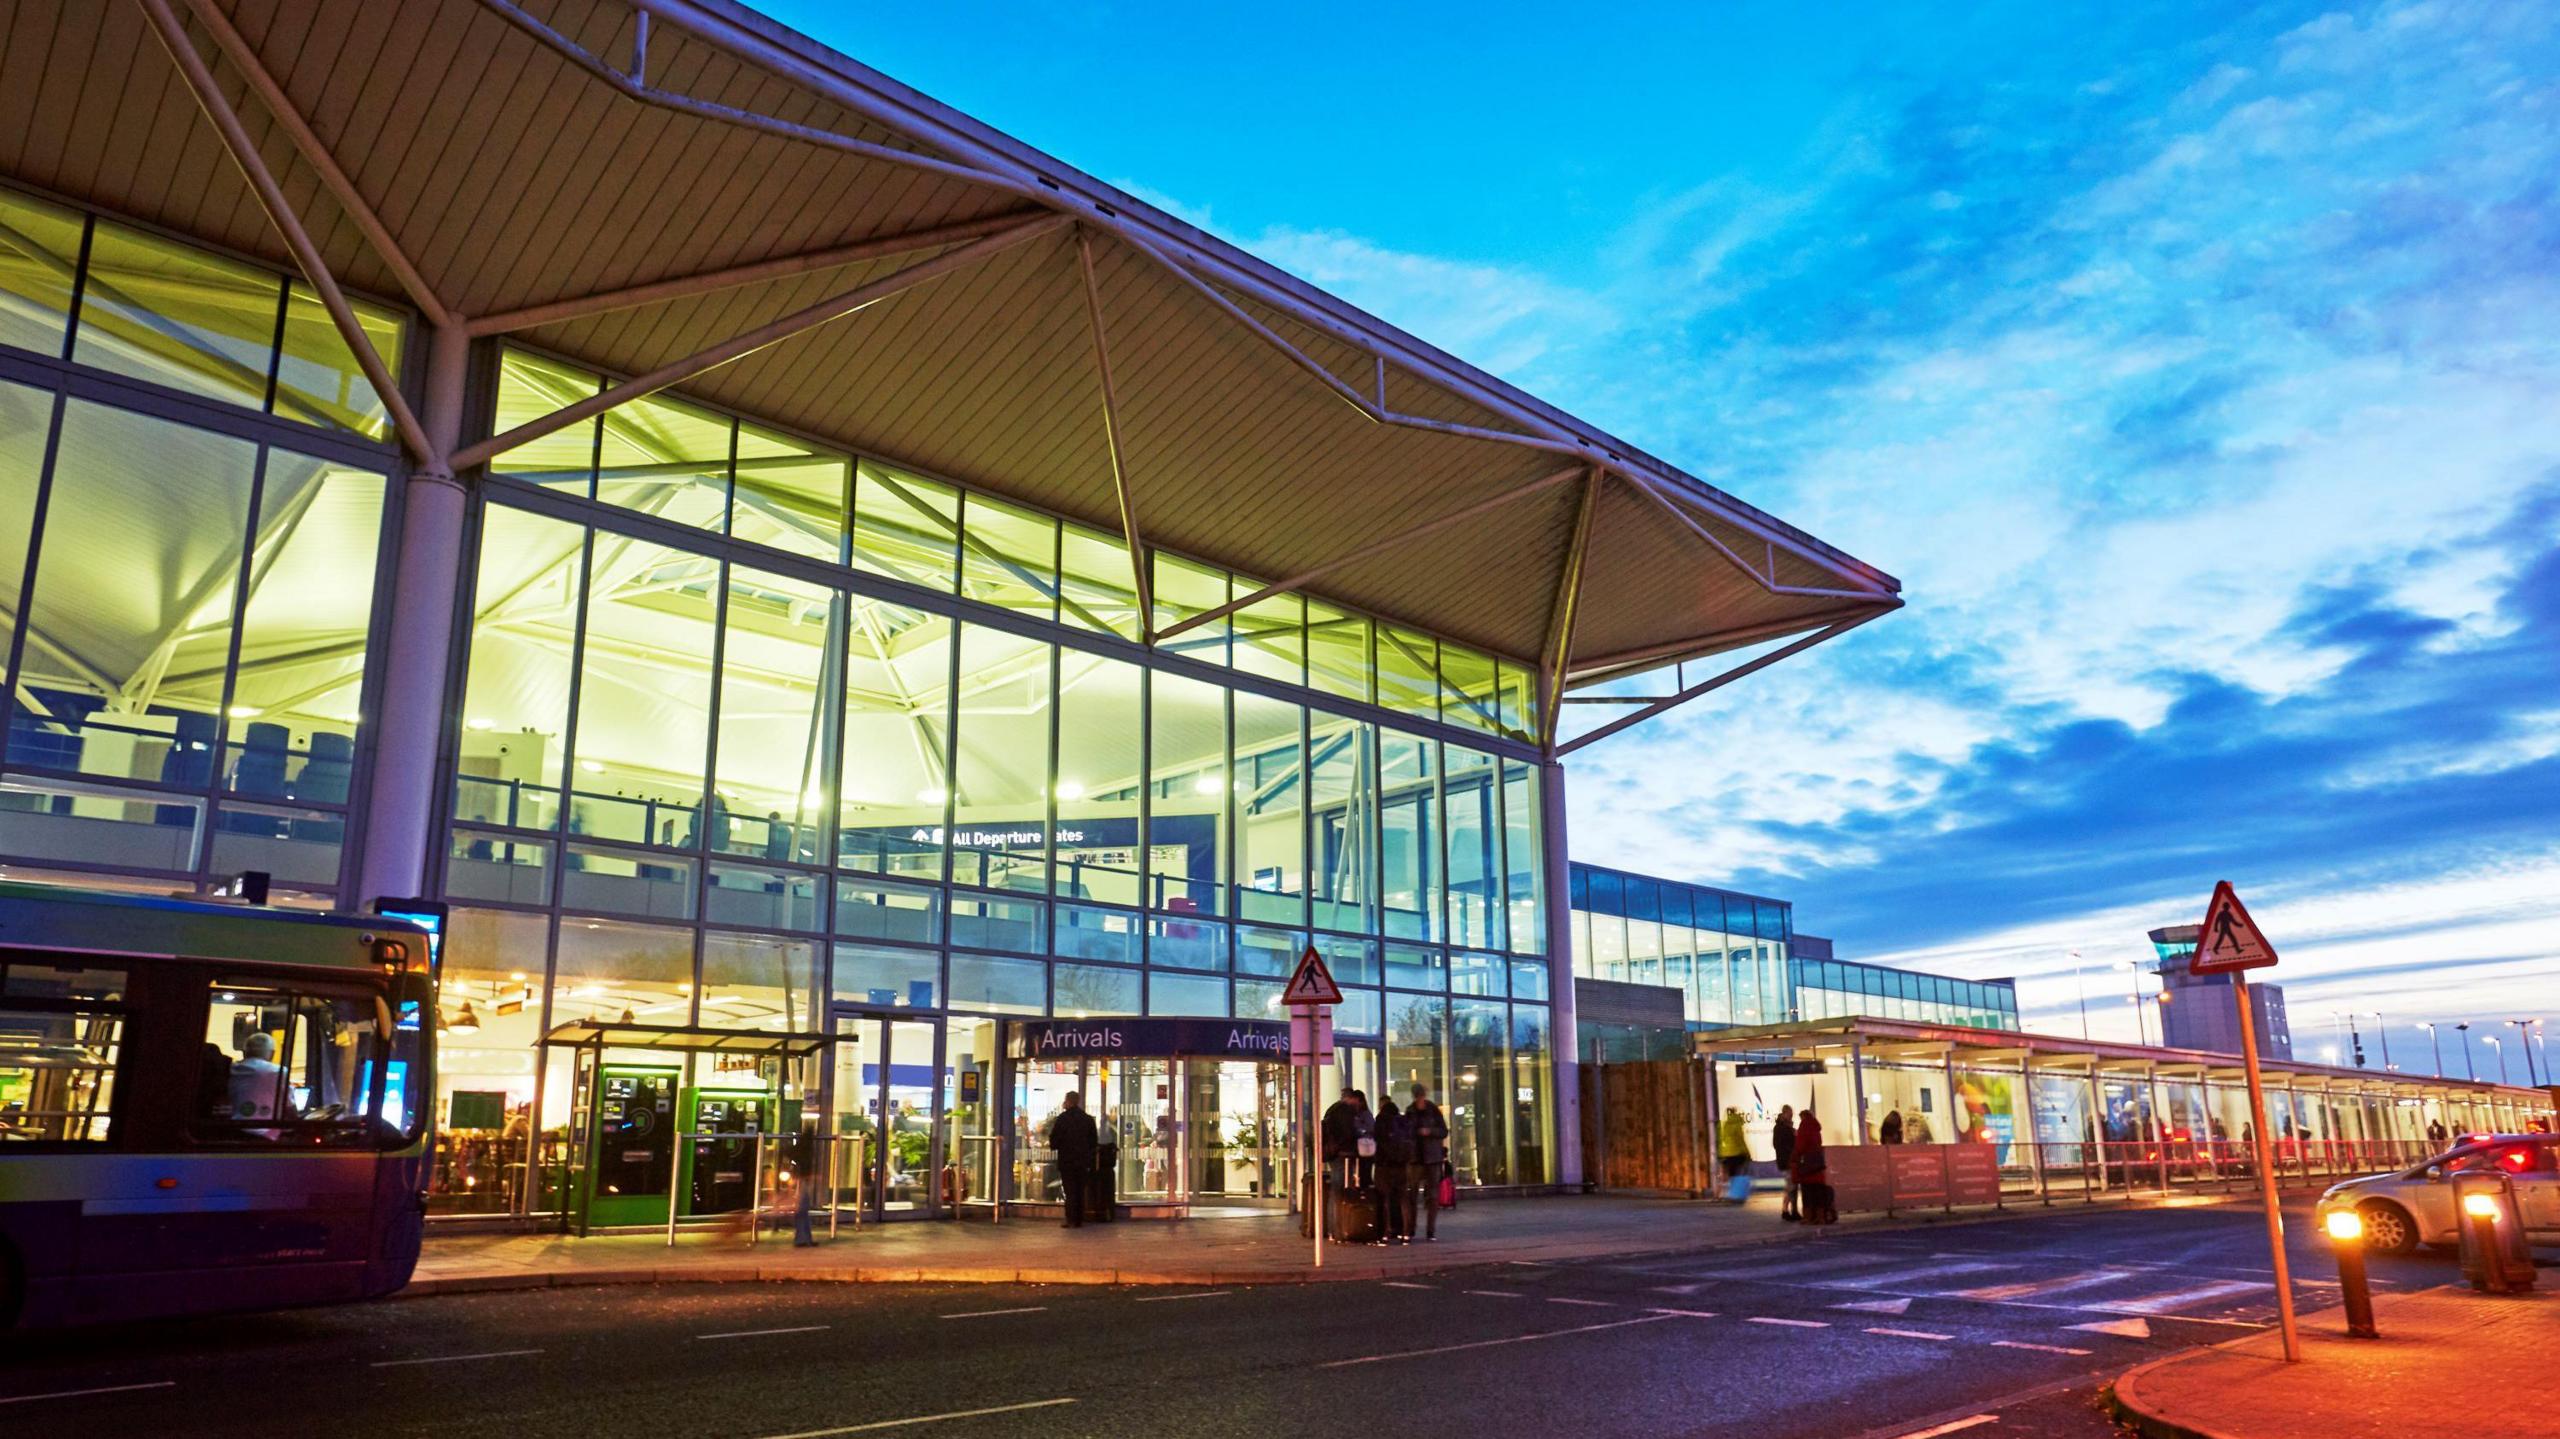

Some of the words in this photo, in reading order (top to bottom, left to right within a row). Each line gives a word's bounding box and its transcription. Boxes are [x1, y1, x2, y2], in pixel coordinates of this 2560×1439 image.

[953, 831, 971, 846] All
[973, 831, 1042, 847] Departure
[1055, 829, 1084, 842] ates
[1041, 1027, 1123, 1049] Arrivals
[1227, 1029, 1289, 1051] Arrivals
